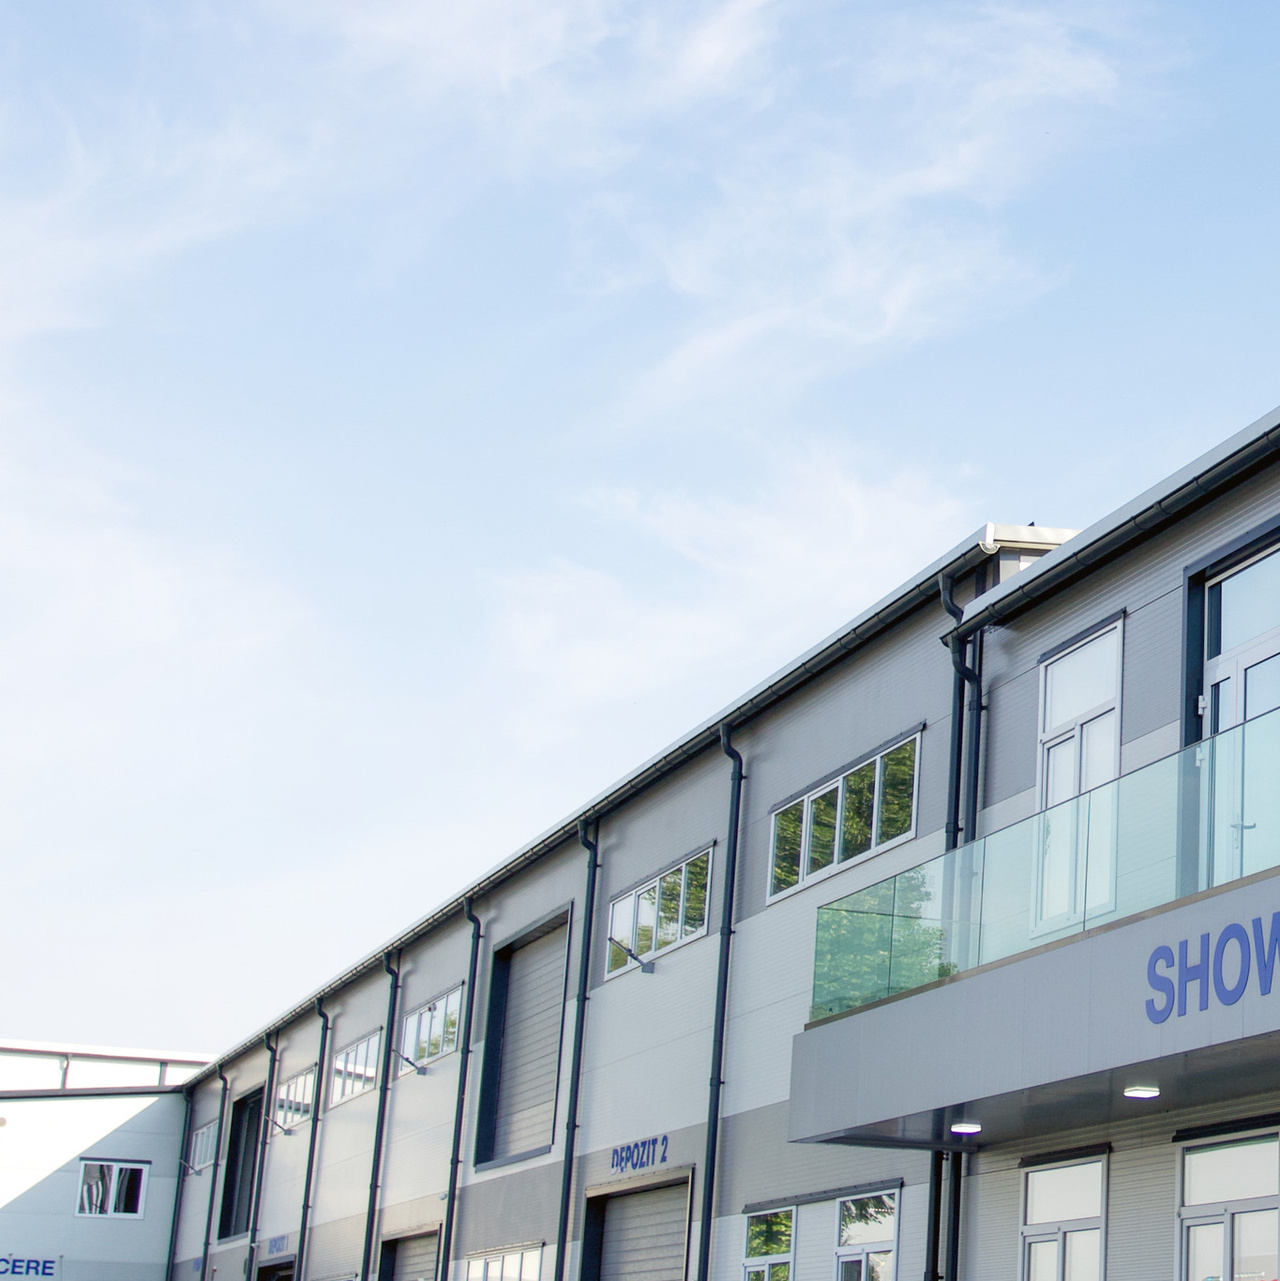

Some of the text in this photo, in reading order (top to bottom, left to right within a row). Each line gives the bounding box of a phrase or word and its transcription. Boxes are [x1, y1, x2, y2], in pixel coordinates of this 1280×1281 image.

[610, 1134, 669, 1175] DEPOZIT 2
[0, 1257, 56, 1276] CERE
